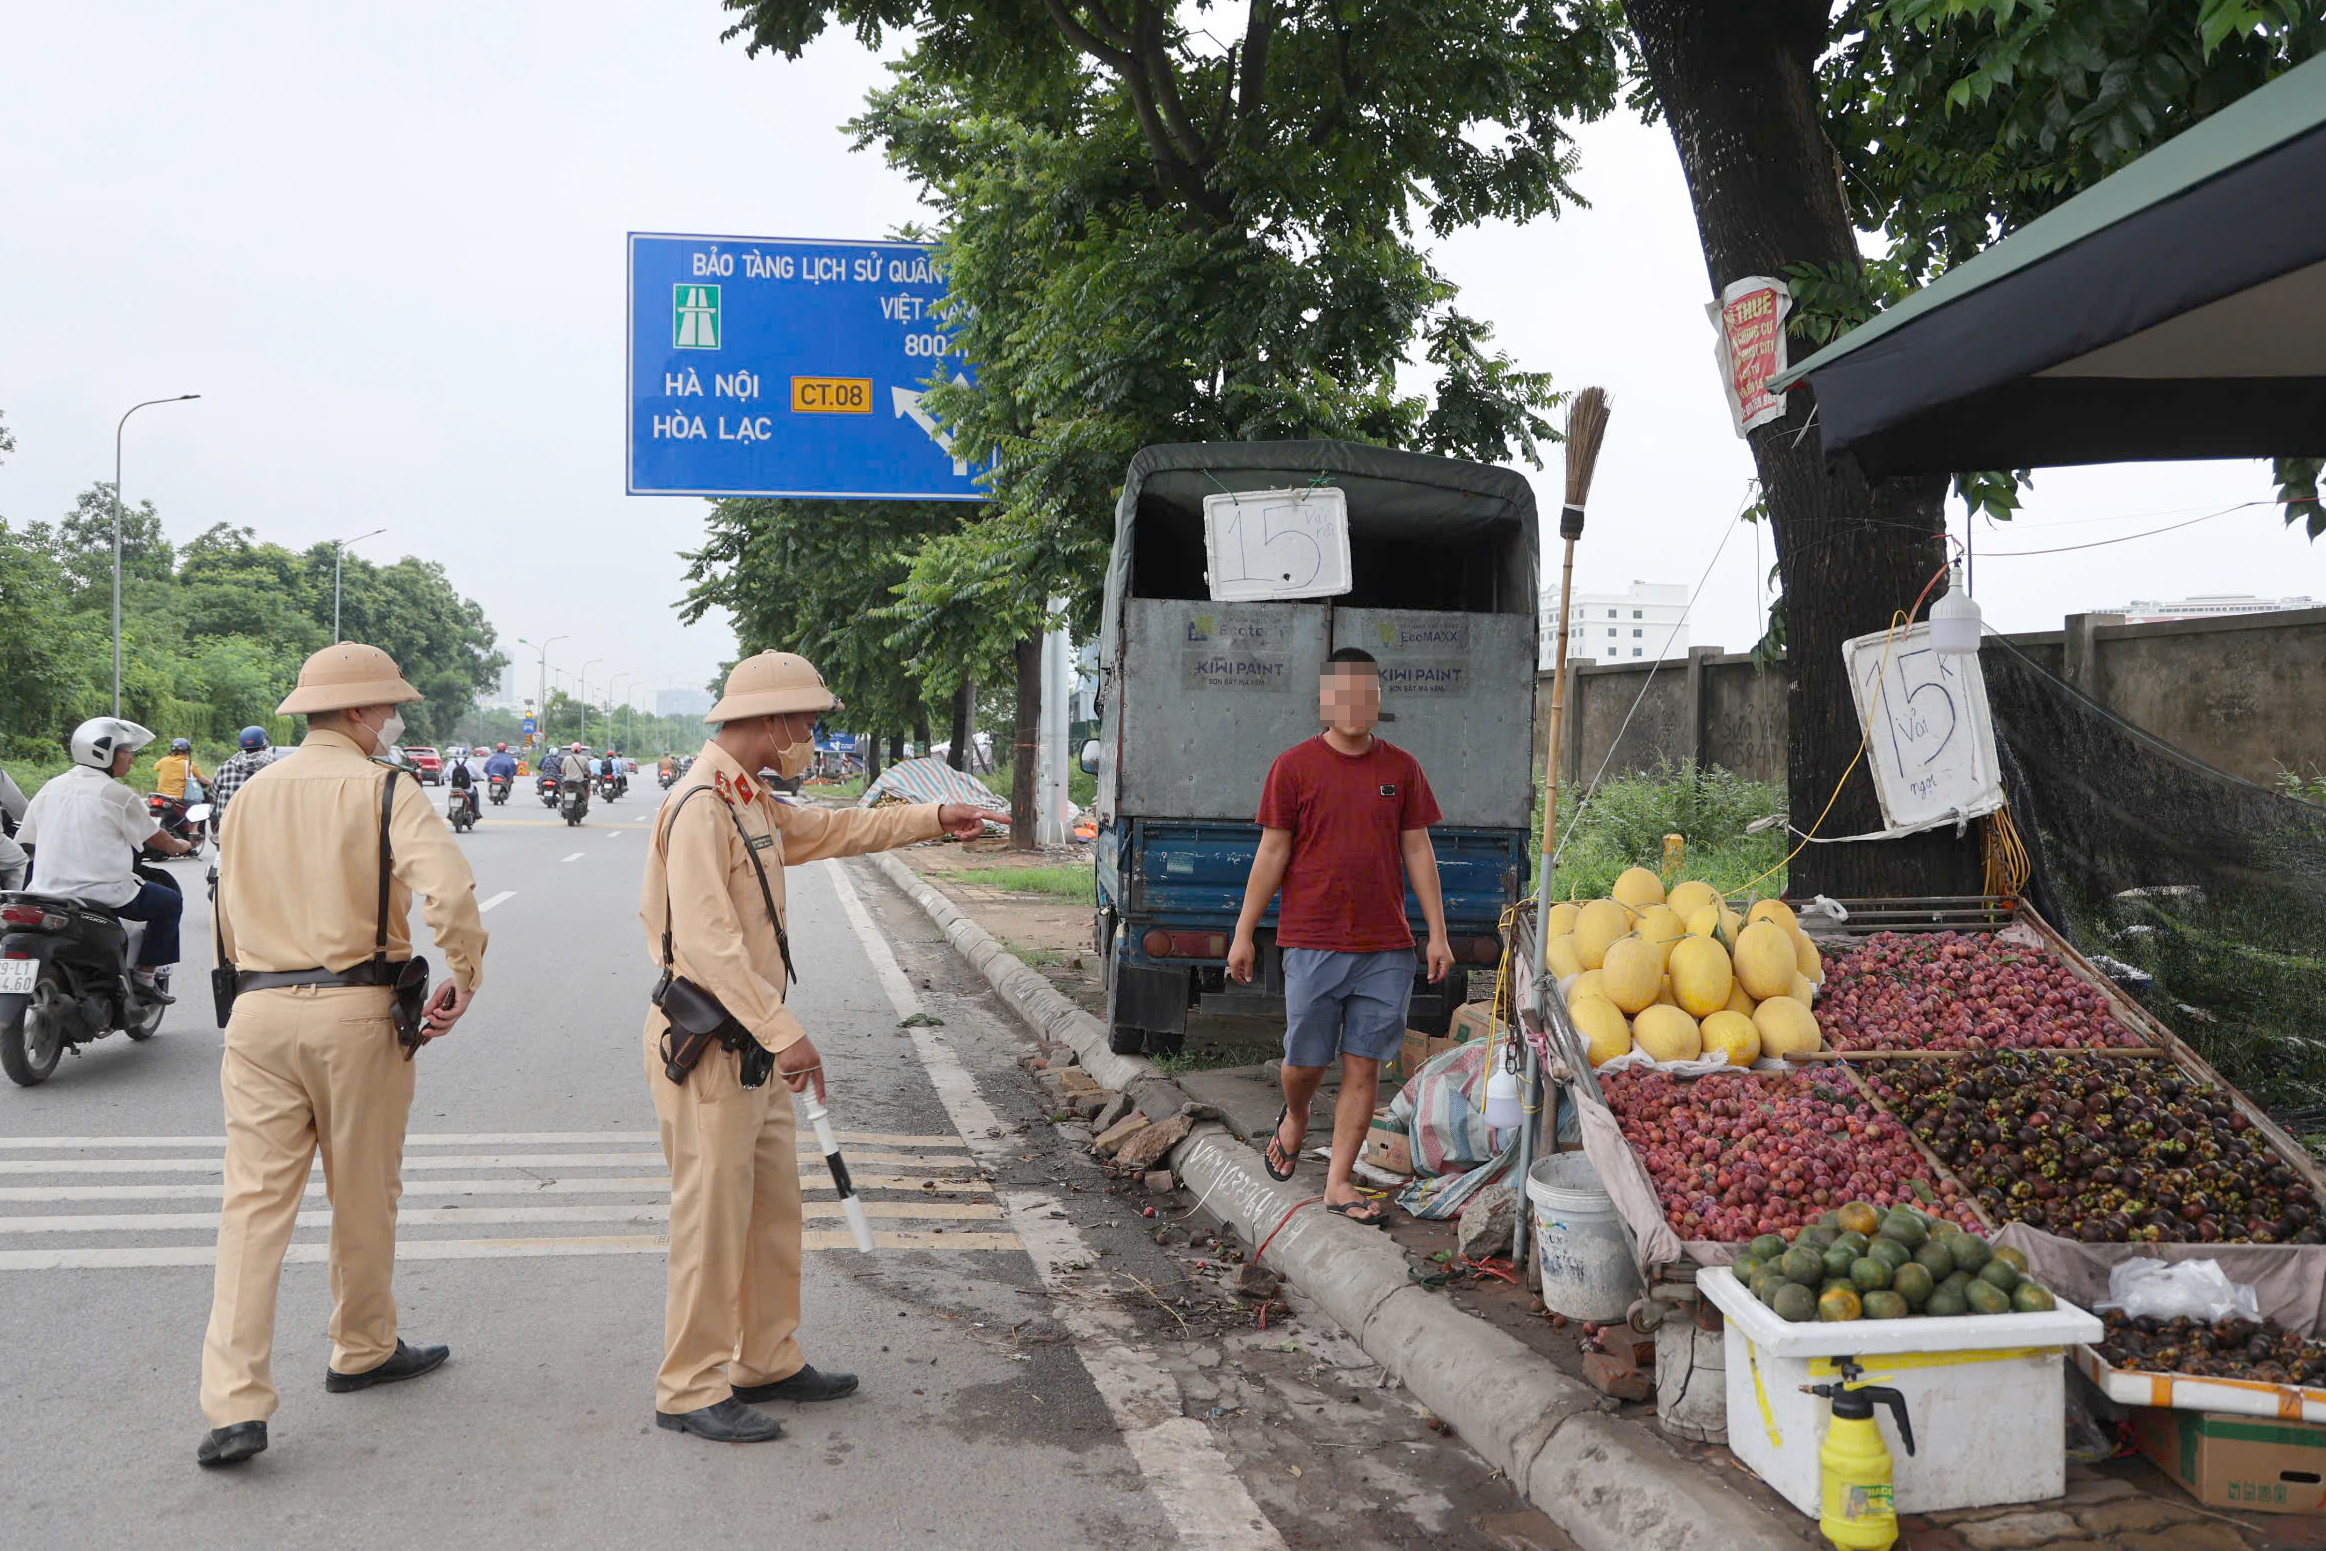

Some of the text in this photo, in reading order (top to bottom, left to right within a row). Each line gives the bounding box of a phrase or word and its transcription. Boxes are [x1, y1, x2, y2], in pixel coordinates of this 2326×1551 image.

[693, 246, 734, 276] BẢO
[742, 249, 794, 278] TÀNG
[803, 257, 846, 285] LỊCH
[853, 251, 883, 282] SỬ
[880, 292, 924, 325] VIỆT
[905, 334, 946, 357] 800
[665, 368, 759, 402] HÀ NỘI
[801, 384, 863, 406] CT.08
[653, 409, 772, 445] HÒA LẠC
[1221, 504, 1321, 592] 15
[1196, 661, 1284, 676] KIWI PAINT
[1378, 668, 1462, 681] KIWI PAINT
[0, 961, 31, 976] 9-L1
